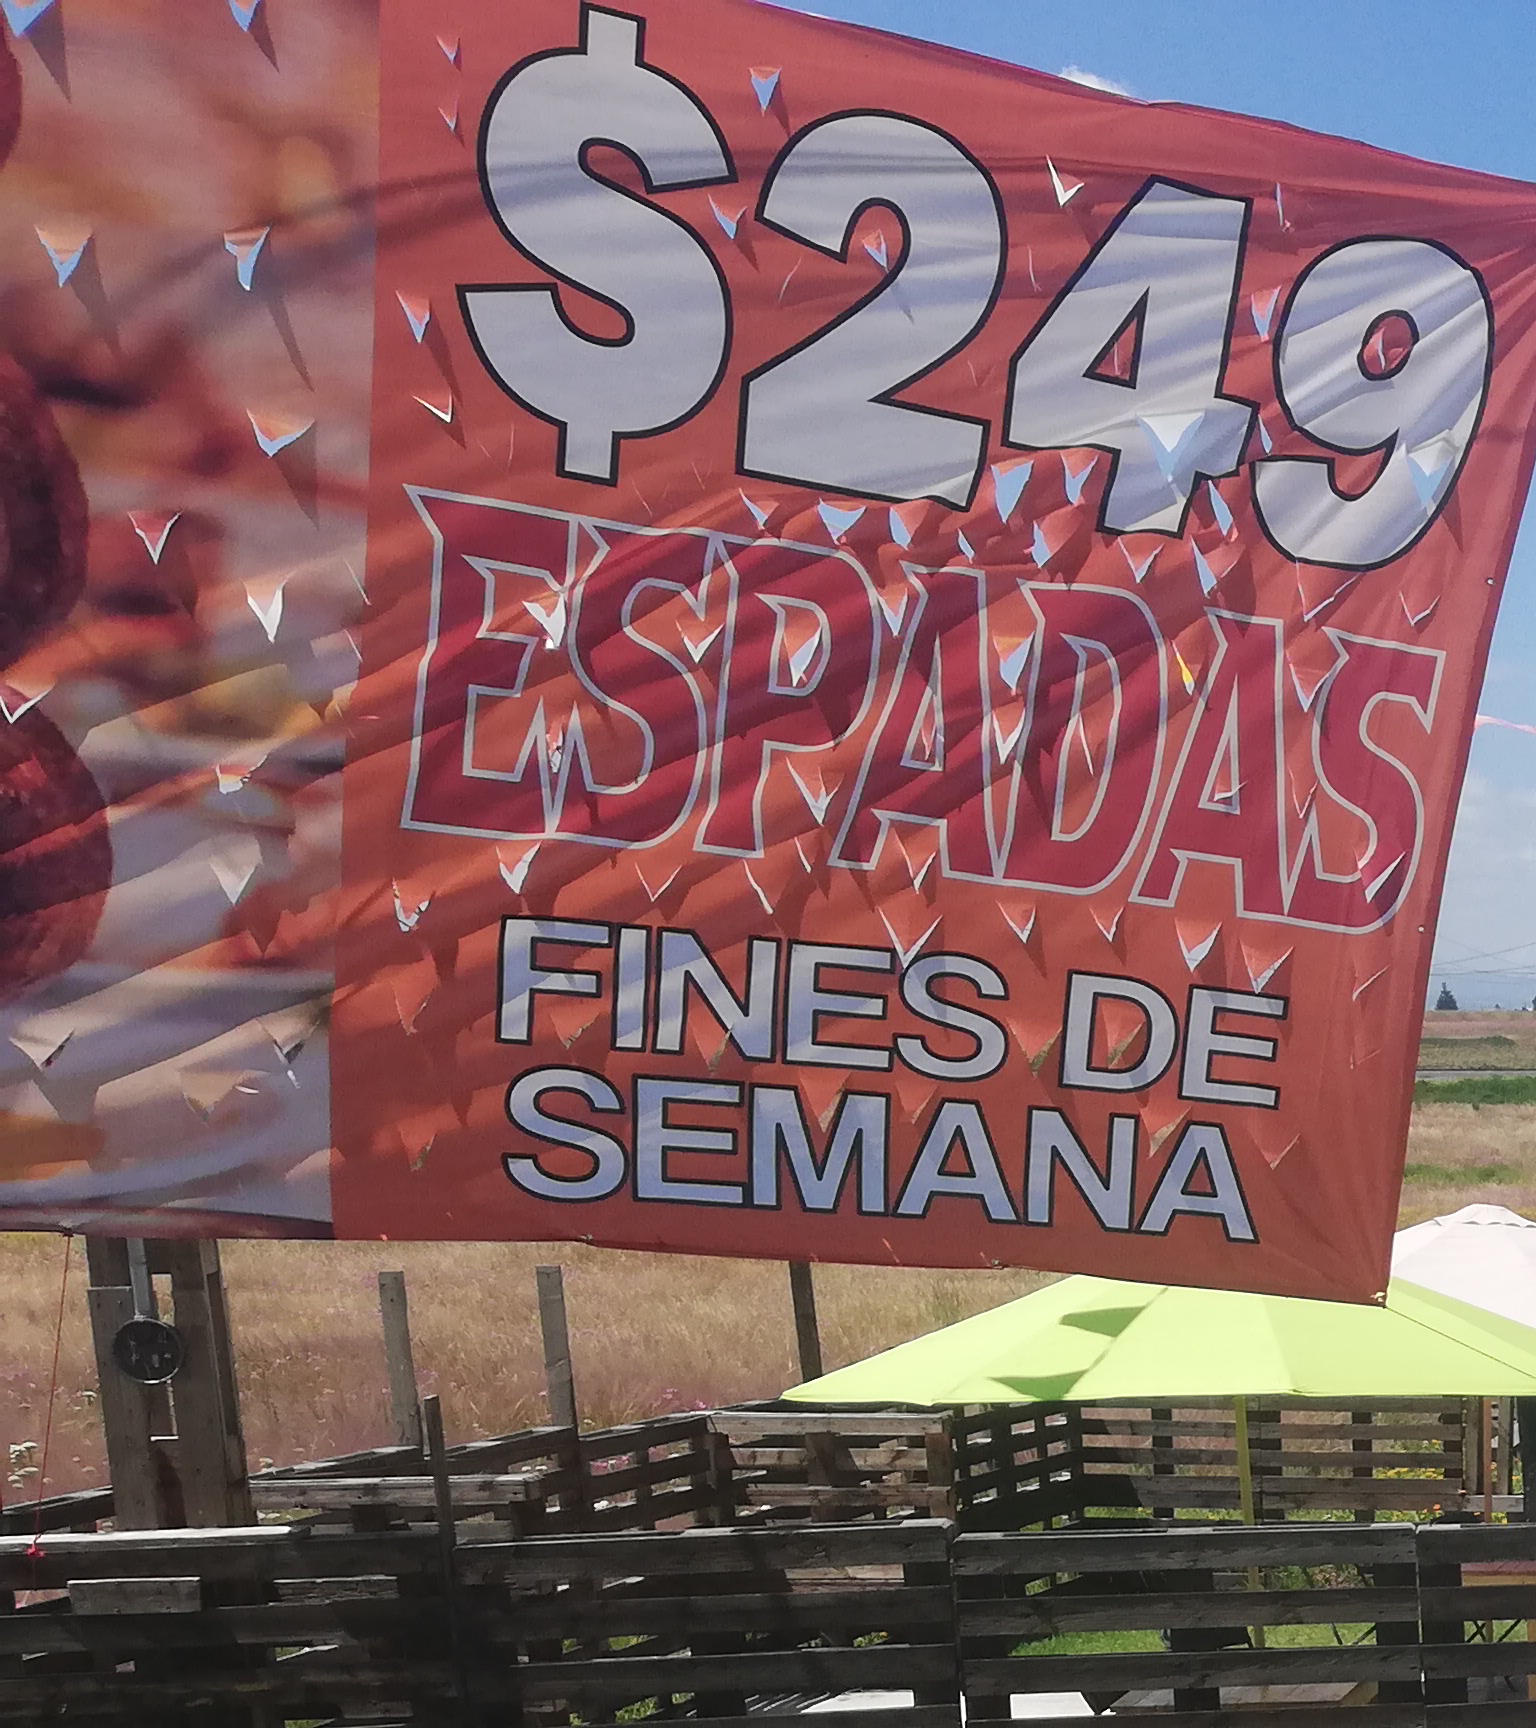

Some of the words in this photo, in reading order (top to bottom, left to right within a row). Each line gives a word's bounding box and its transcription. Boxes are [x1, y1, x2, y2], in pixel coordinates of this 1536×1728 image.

[457, 4, 1496, 569] $249
[401, 484, 1447, 936] ESPADAS
[496, 915, 1007, 1081] FINES
[1061, 972, 1289, 1110] DE
[503, 1066, 1257, 1244] SEMANA
